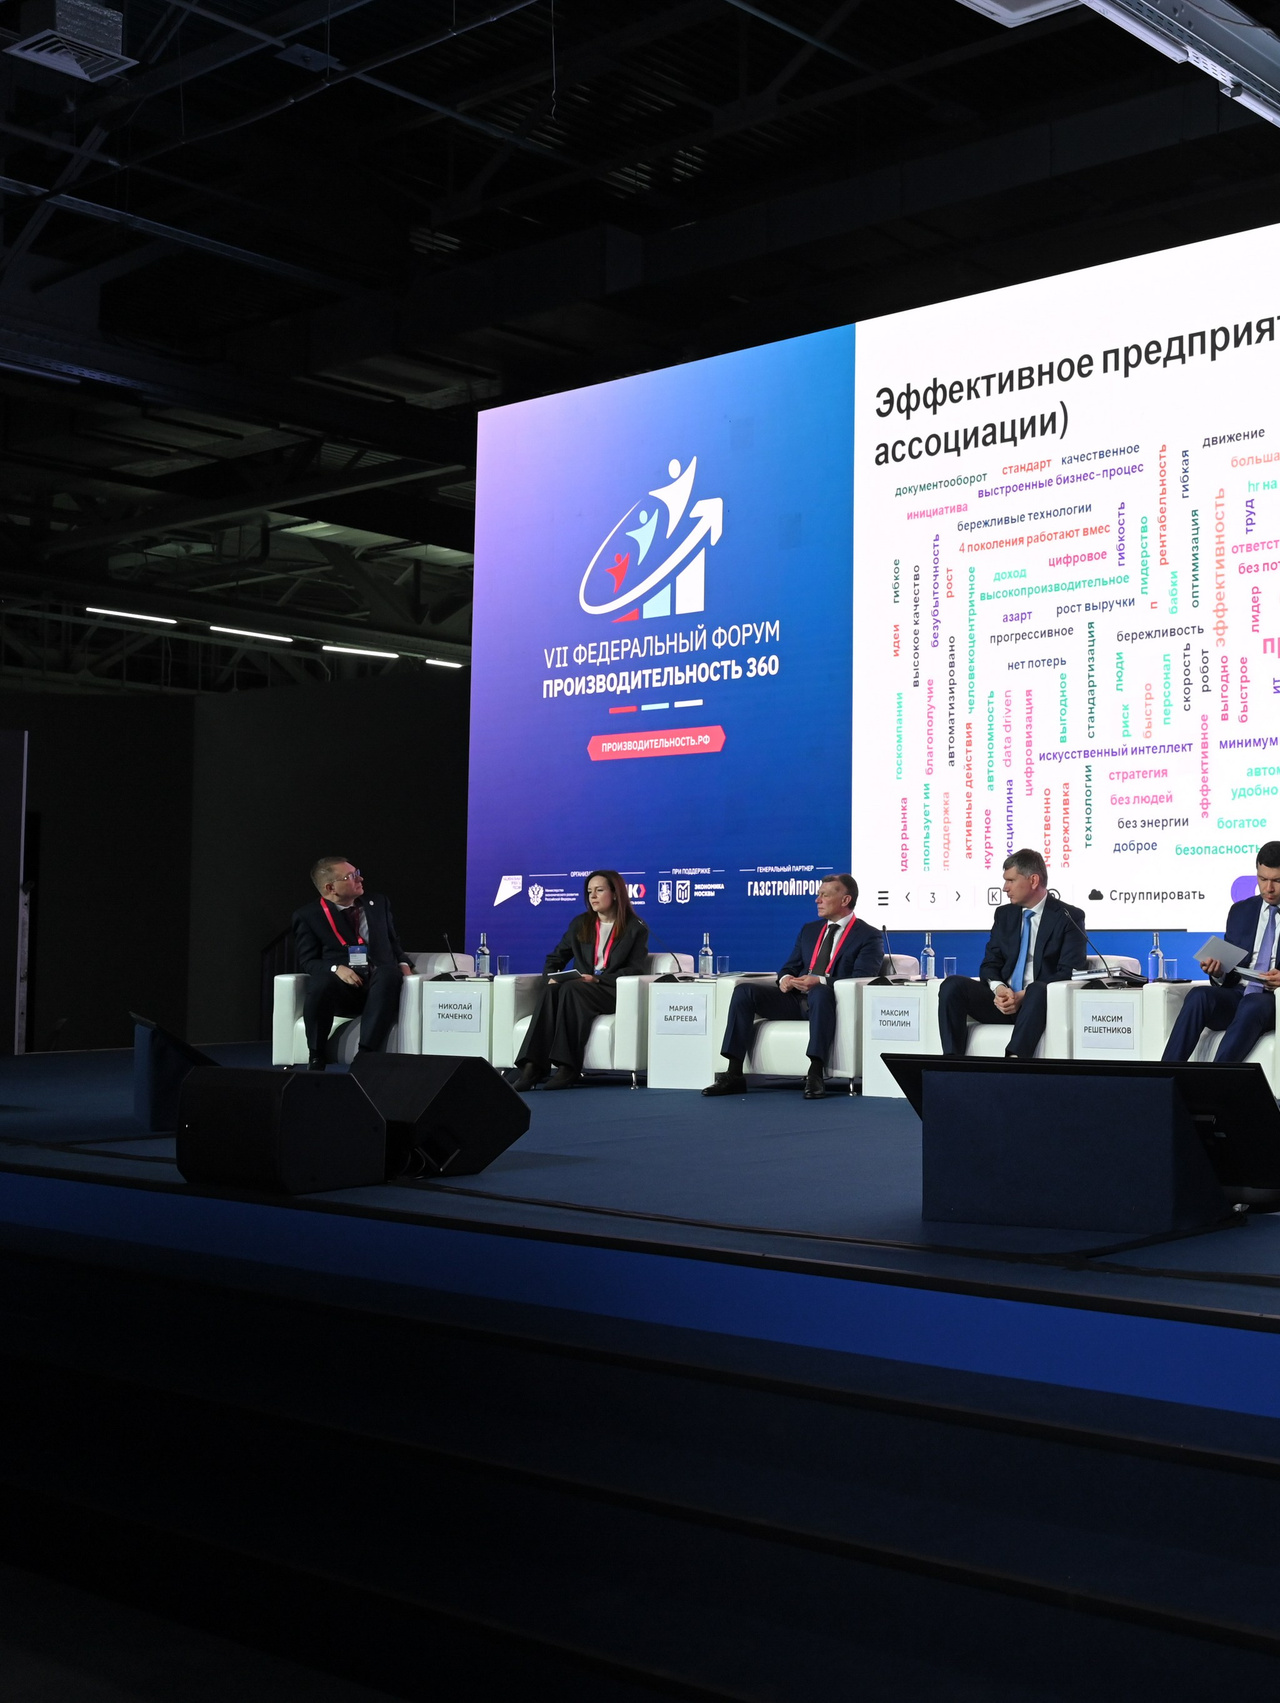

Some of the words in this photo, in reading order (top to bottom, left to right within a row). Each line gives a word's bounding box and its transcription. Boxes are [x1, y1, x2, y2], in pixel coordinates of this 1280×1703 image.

[875, 353, 1094, 421] Эффективное
[874, 400, 1070, 466] ассоциации)
[1202, 429, 1265, 448] движение
[1061, 443, 1140, 466] качественное
[1002, 459, 1052, 475] стандарт
[895, 472, 987, 498] документооборот
[977, 475, 1053, 498] выстроенные
[1056, 457, 1143, 485] бизнес-процес
[1248, 481, 1260, 492] hr
[1263, 480, 1277, 490] на
[907, 503, 968, 520] инициатива
[958, 514, 1025, 532] бережливые
[1028, 504, 1091, 521] технологии
[1049, 551, 1107, 567] цифровое
[1213, 488, 1228, 647] эффективность
[1238, 563, 1259, 574] без
[980, 573, 1130, 602] высокопроизводительное
[544, 646, 568, 668] VII
[573, 624, 706, 666] ФЕДЕРАЛЬНЫЙ
[712, 620, 779, 649] ФОРУМ
[990, 627, 1073, 646] прогрессивное
[1117, 625, 1204, 644] бережливость
[543, 659, 743, 698] ПРОИЗВОДИТЕЛЬНОСТЬ
[747, 655, 779, 677] 360
[1183, 643, 1193, 711] скорость
[1238, 657, 1250, 723] быстрое
[925, 679, 935, 775] благополучие
[601, 735, 711, 753] ПРОИЗВОДИТЕЛЬНОСТЬ.РФ
[1024, 690, 1034, 796] цифровизация
[1220, 737, 1278, 750] минимум
[1039, 744, 1128, 763] искусственный
[1131, 743, 1193, 755] интеллект
[1109, 769, 1167, 782] стратегия
[1111, 794, 1130, 805] без
[1133, 791, 1172, 805] людей
[1231, 784, 1278, 800] удобно
[1118, 818, 1137, 829] без
[1140, 818, 1188, 830] энергии
[1113, 840, 1157, 854] доброе
[1110, 890, 1205, 903] Сгруппировать
